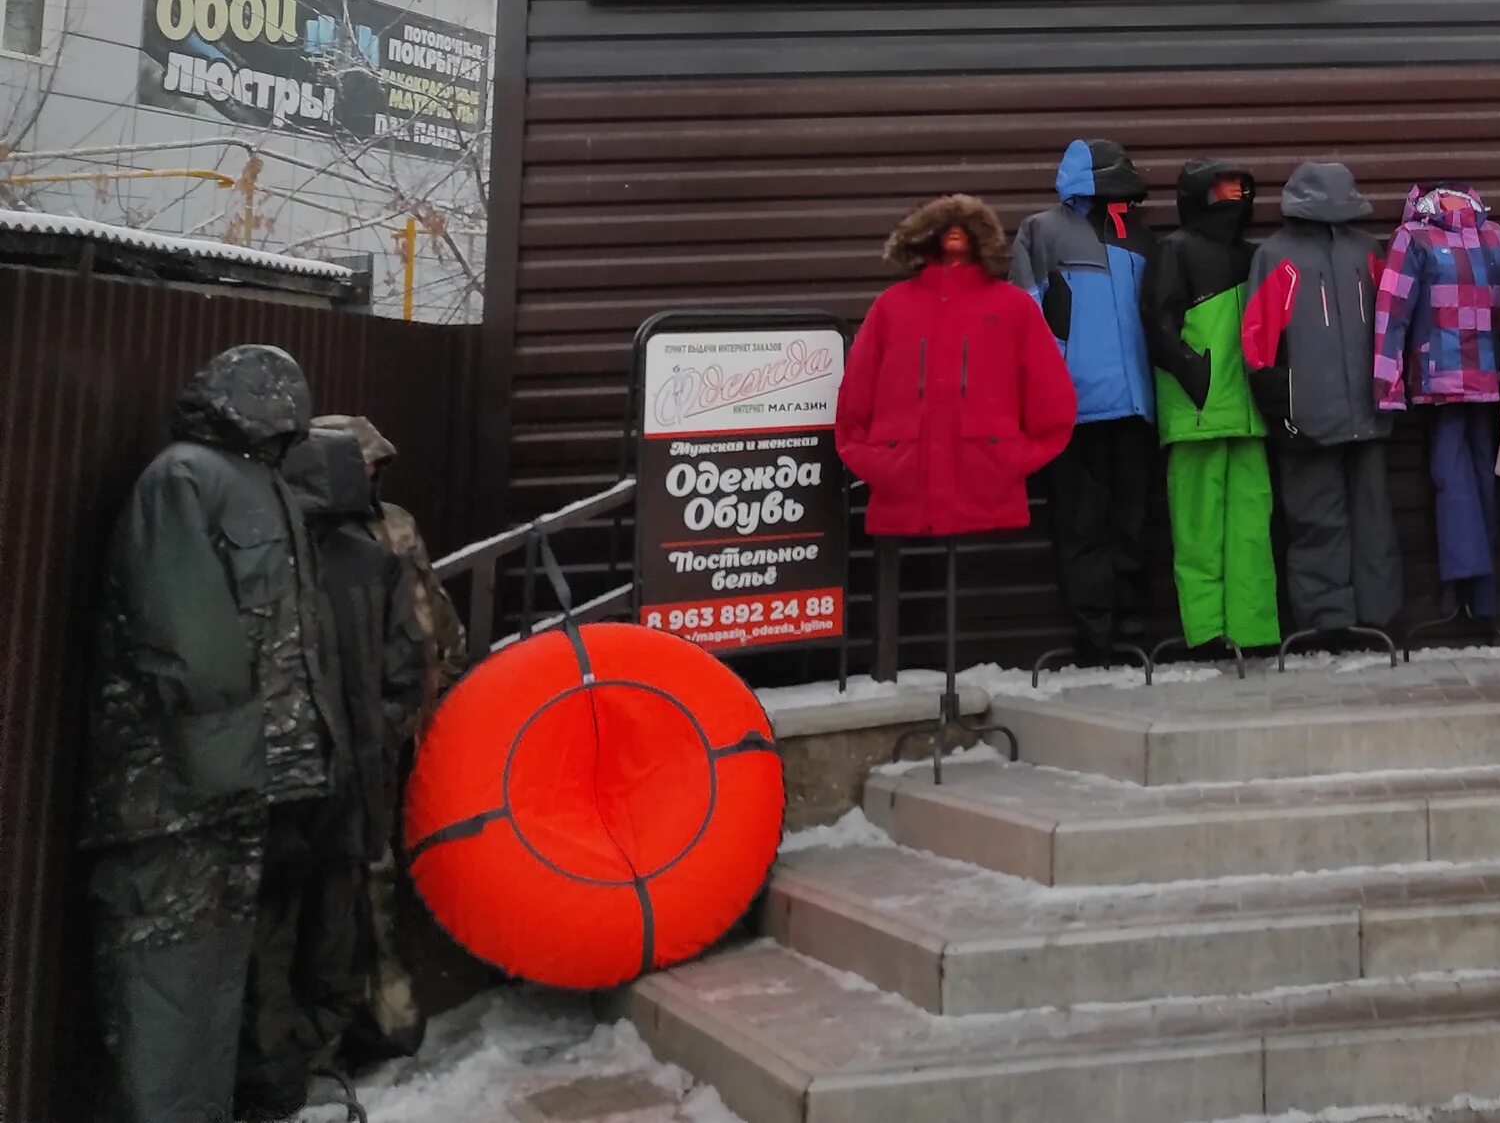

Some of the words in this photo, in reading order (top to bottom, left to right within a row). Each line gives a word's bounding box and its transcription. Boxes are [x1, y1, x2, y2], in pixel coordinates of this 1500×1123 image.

[688, 345, 717, 353] ВЫДАЧИ
[718, 344, 750, 352] ИНТЕРНЕТ
[752, 343, 782, 352] ЗАКАЗОВ
[655, 339, 832, 426] Одежда
[733, 404, 764, 414] ИНТЕРНЕТ
[769, 402, 827, 412] МАГАЗИН
[670, 440, 744, 457] Мужская
[746, 440, 755, 451] и
[757, 437, 818, 450] женская
[666, 457, 822, 497] Одежда
[684, 492, 804, 535] Обувь
[668, 544, 819, 573] Постельное
[712, 566, 778, 591] бельё
[647, 612, 662, 629] 8
[669, 607, 714, 630] 963
[720, 602, 764, 624] 892
[770, 599, 798, 620] 24
[806, 596, 834, 616] 88
